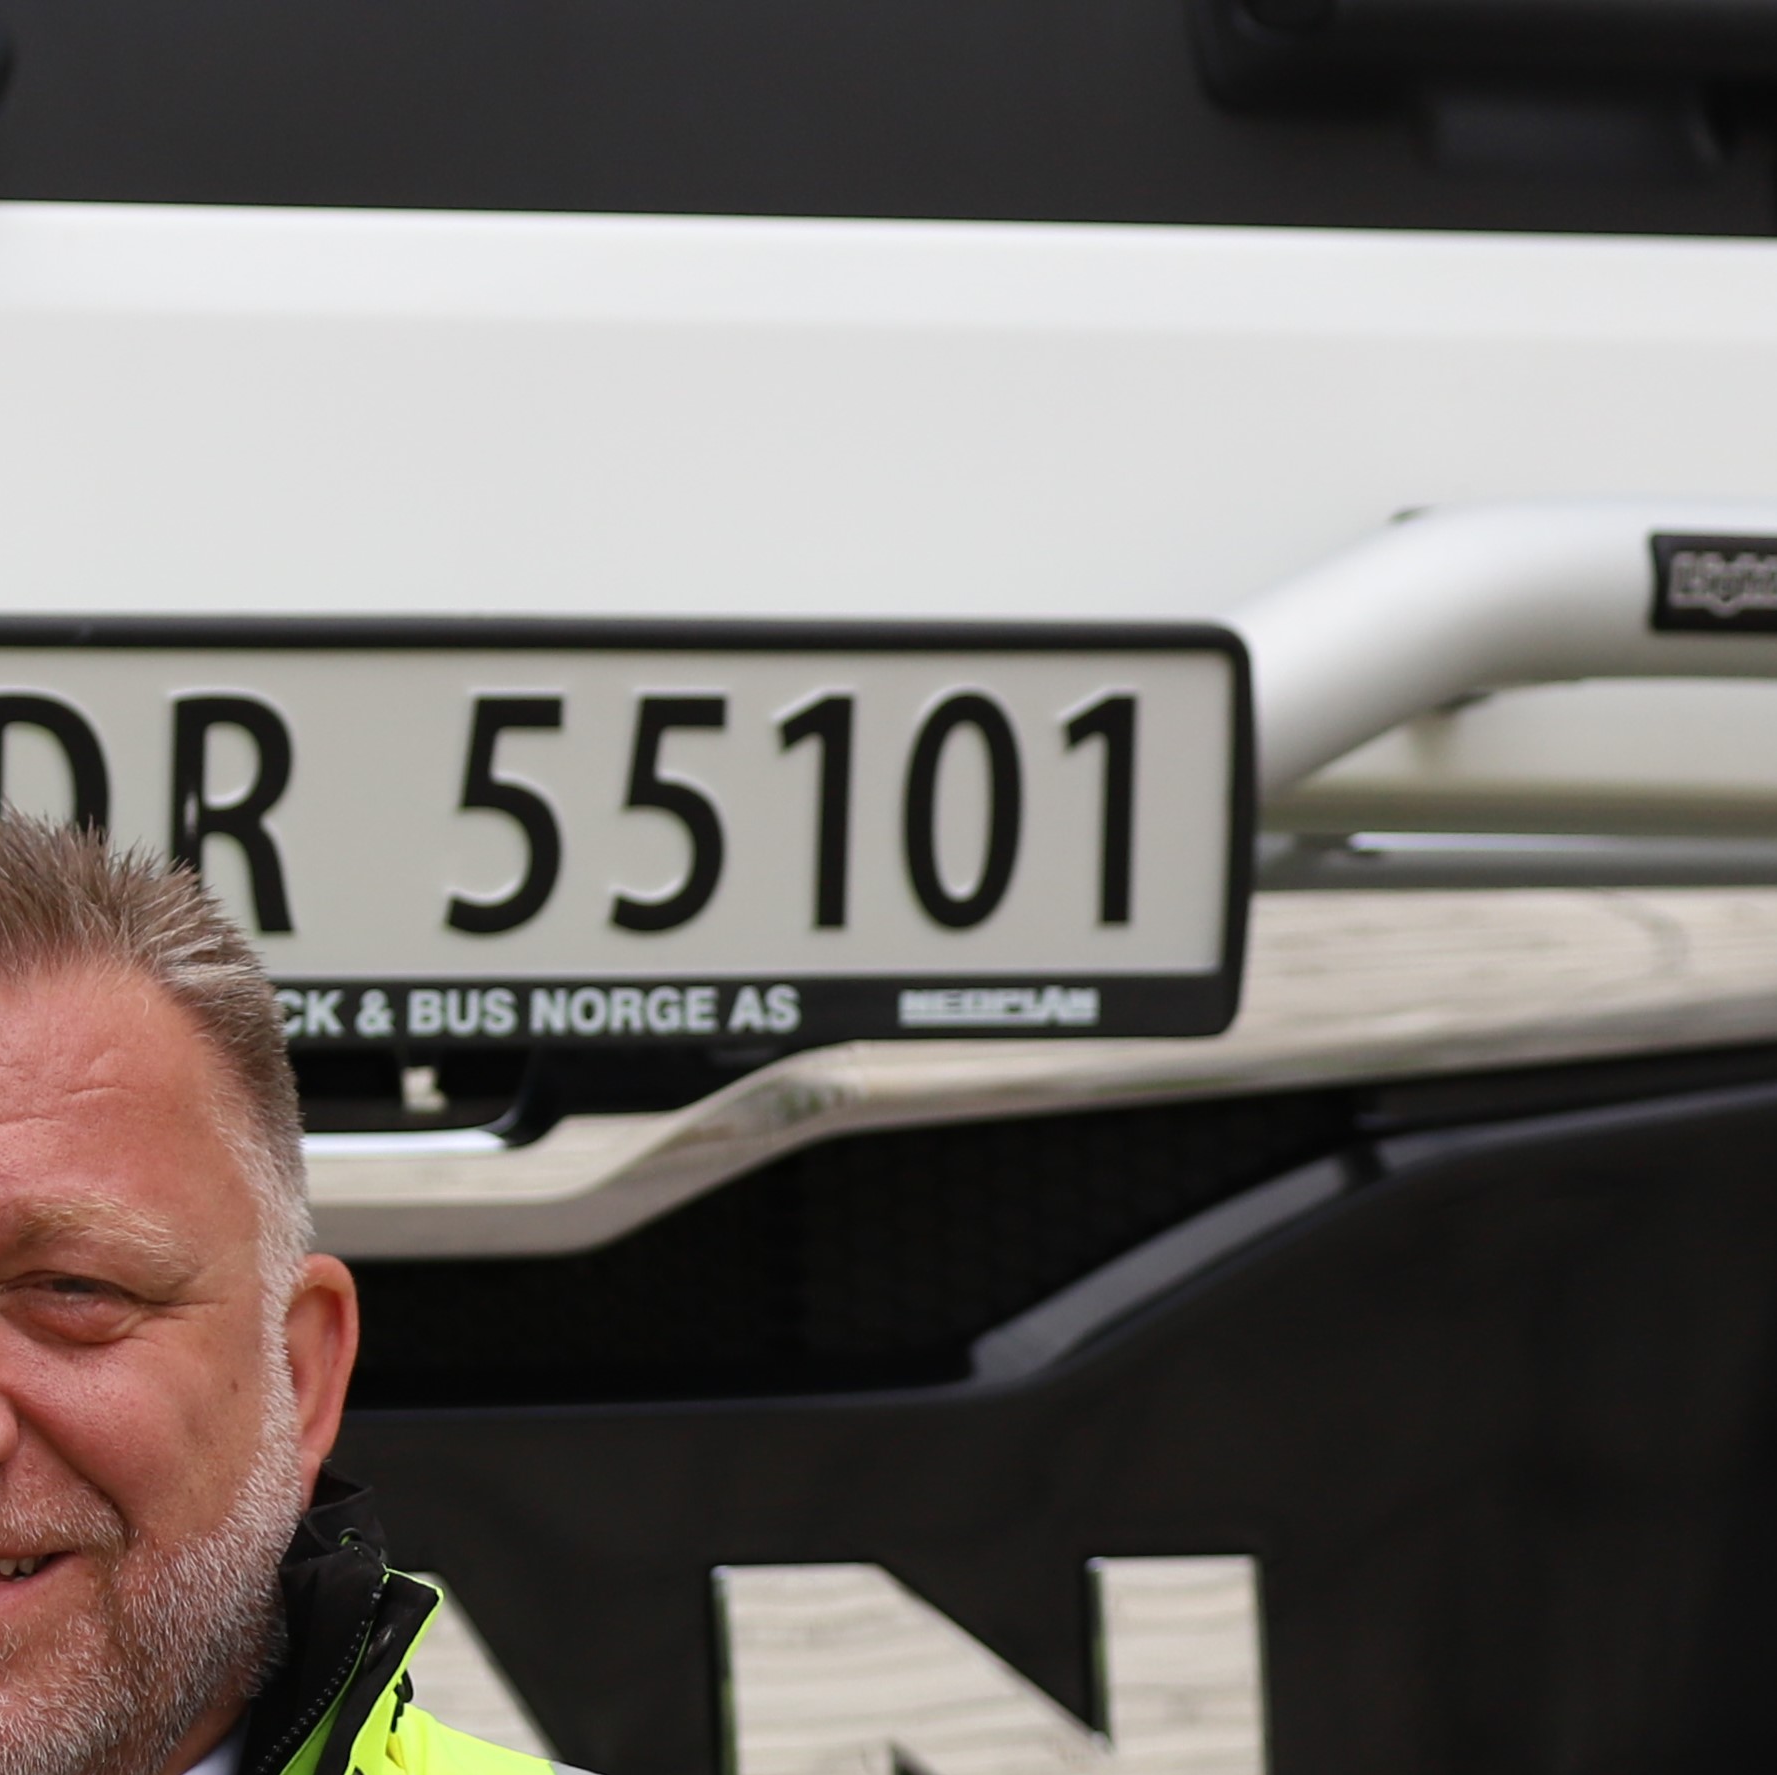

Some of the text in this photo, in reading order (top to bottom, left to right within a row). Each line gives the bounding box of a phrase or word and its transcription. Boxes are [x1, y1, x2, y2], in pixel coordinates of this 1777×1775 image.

[446, 690, 1138, 935] 55101
[271, 984, 800, 1037] CK & BUS NORGE AS
